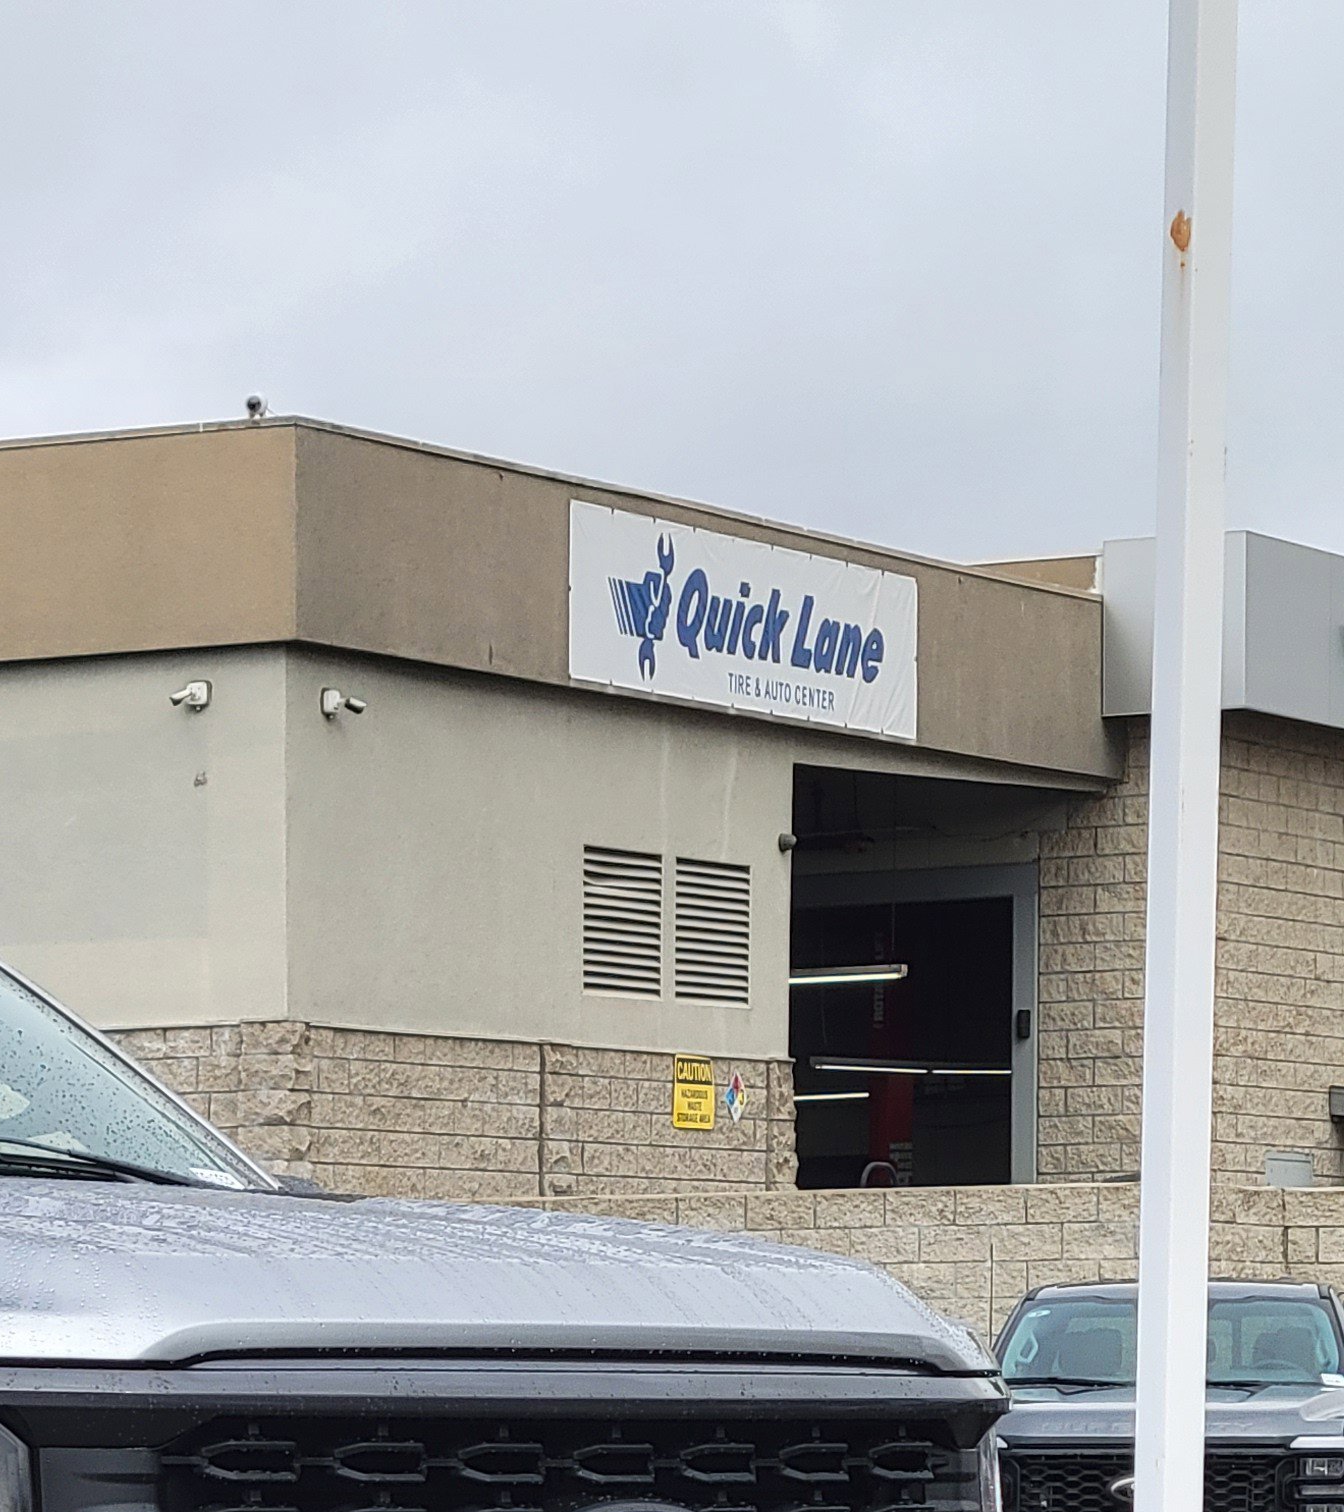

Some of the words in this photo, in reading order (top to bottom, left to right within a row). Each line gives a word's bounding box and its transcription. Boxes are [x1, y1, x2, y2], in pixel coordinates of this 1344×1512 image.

[676, 568, 789, 664] Quick
[790, 595, 885, 684] Lane
[728, 672, 751, 697] TIRE
[755, 679, 762, 698] &
[765, 680, 791, 703] AUTO
[794, 684, 835, 712] CENTER
[677, 1061, 712, 1082] CAUTION
